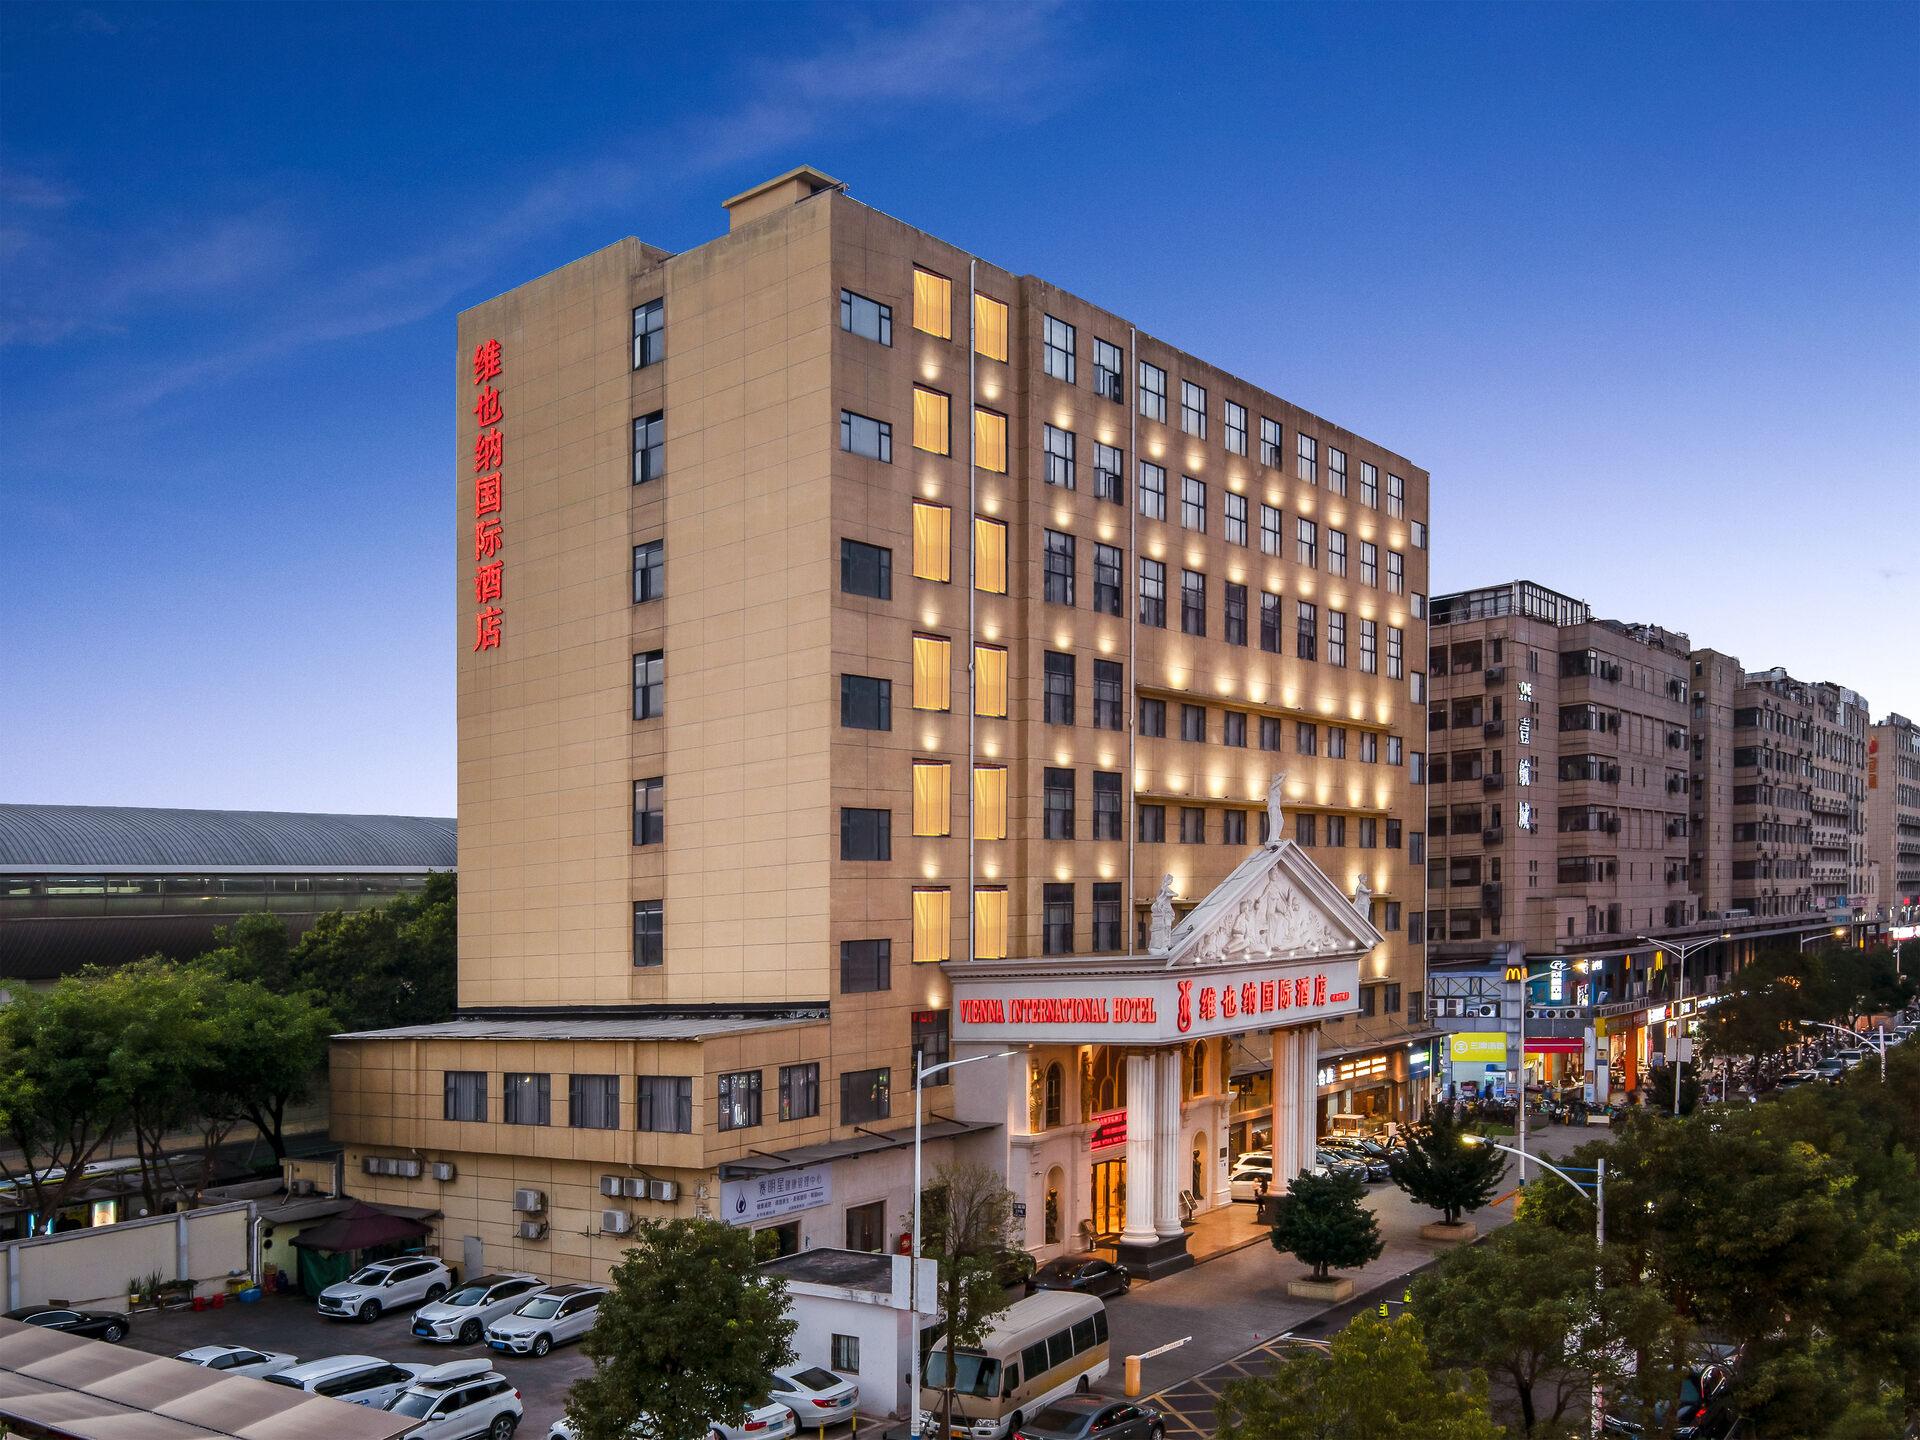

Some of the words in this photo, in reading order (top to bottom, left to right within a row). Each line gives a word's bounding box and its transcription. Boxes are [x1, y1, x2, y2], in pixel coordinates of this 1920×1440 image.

[473, 338, 503, 652] 维也纳国际酒店
[959, 999, 1005, 1024] VIENNA
[1008, 997, 1109, 1024] INTERNATIONAL
[1112, 997, 1157, 1024] HOTEL
[1199, 974, 1328, 1020] 维也纳国际酒店
